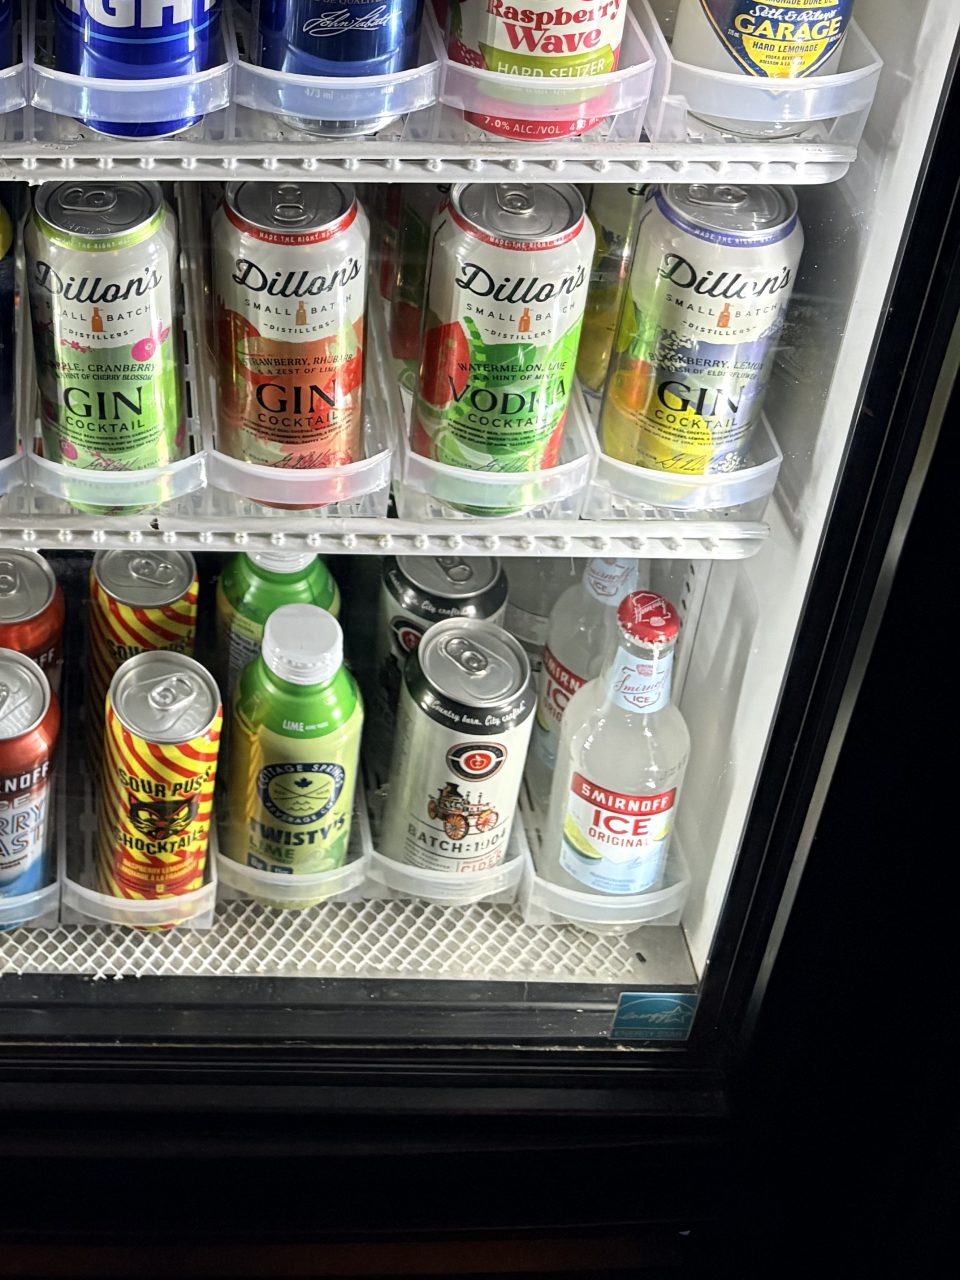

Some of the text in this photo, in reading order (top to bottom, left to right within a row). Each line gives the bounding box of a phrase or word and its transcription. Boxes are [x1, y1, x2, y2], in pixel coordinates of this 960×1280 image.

[749, 4, 783, 21] Seth
[503, 21, 602, 54] Wave
[734, 13, 843, 41] GARAGE
[752, 41, 819, 53] HARD LEMONADE
[549, 58, 607, 78] SELTZER
[512, 120, 565, 135] ALC./VOL.
[35, 260, 163, 304] Dillon's
[231, 257, 362, 300] Dillon's
[455, 261, 586, 305] Dillon's
[657, 251, 792, 299] Dillon's
[106, 304, 152, 322] BATCH
[243, 298, 292, 317] SMALL
[466, 303, 516, 322] SMALL
[665, 293, 714, 317] SMALL
[268, 320, 331, 334] DISTILLERS
[490, 328, 553, 341] DISTILLERS
[63, 386, 144, 420] GIN
[255, 380, 338, 414] GIN
[657, 379, 746, 417] GIN
[65, 415, 146, 434] COCKTAIL
[257, 411, 339, 428] COCKTAIL
[654, 409, 738, 429] COCKTAIL
[612, 672, 667, 694] Smirnoff
[282, 719, 304, 732] LIME
[429, 699, 500, 727] Country City
[118, 765, 212, 798] SOUR PUSS
[257, 763, 344, 789] COTTAGE SPRINGS
[581, 783, 670, 811] SMIRNOFF
[592, 809, 652, 837] ICE
[114, 824, 205, 855] SHOCKTAILS
[249, 833, 296, 860] LIME
[588, 826, 652, 848] ORIGINAL
